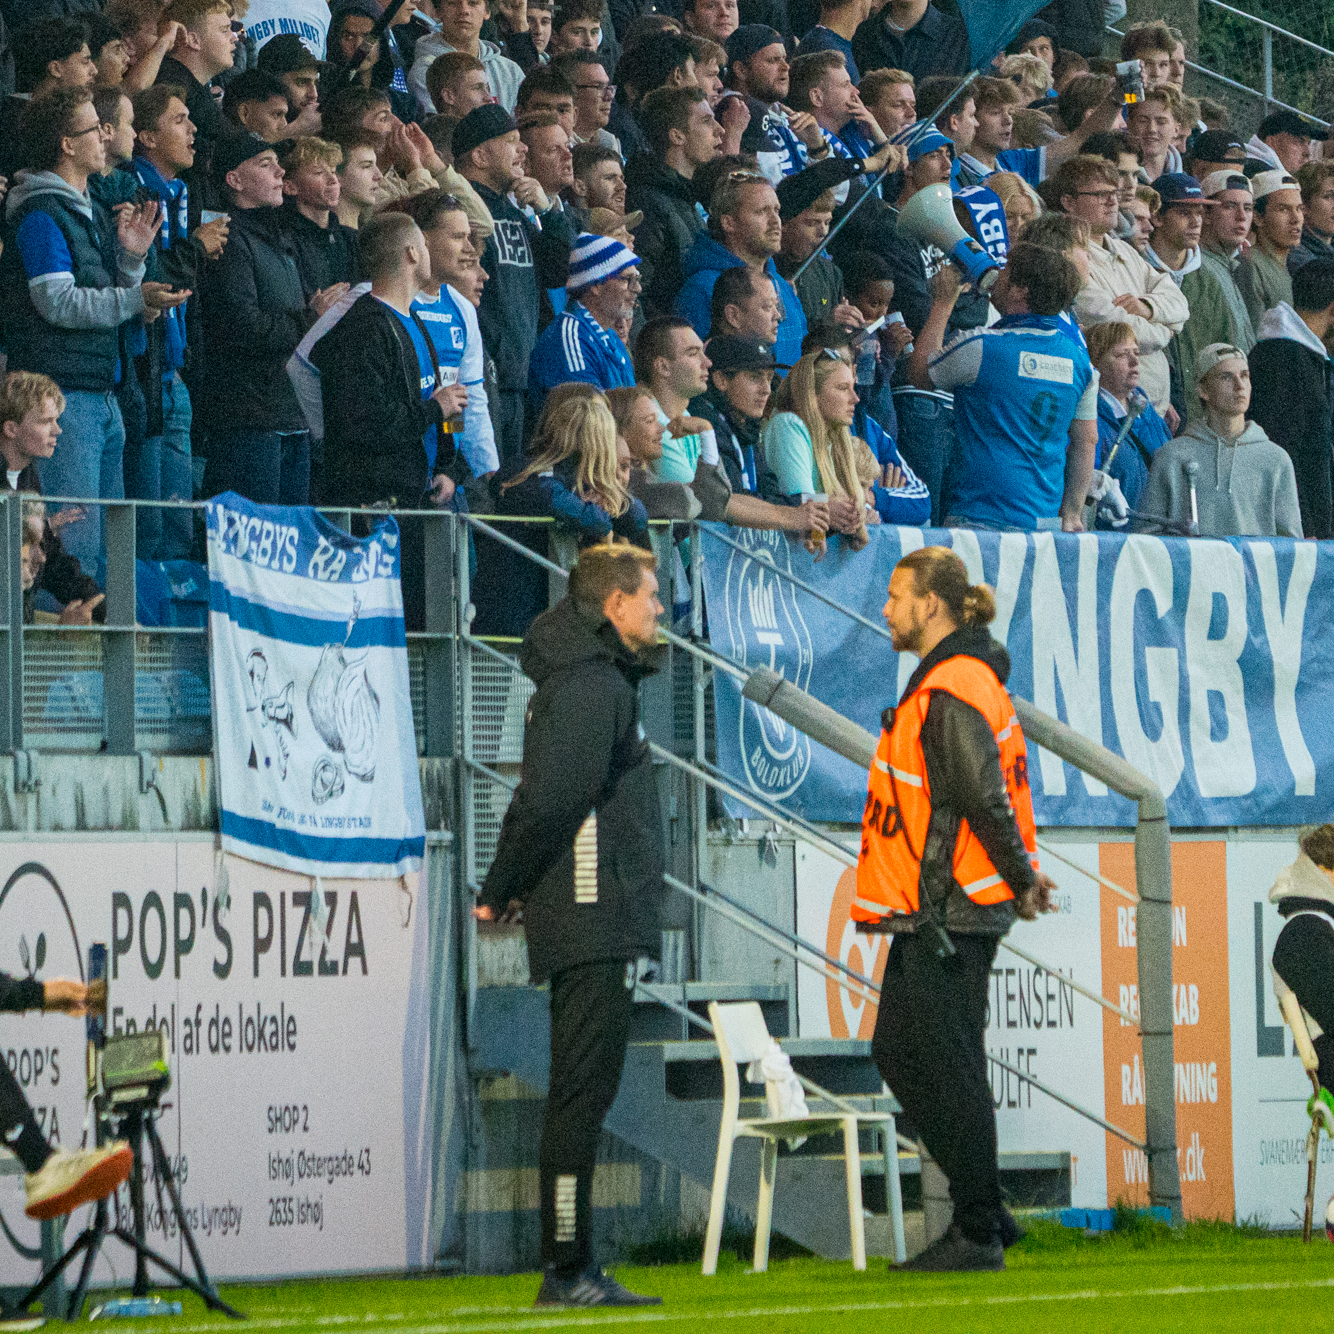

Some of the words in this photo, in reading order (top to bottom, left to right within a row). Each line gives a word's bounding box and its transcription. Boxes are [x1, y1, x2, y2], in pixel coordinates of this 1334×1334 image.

[751, 746, 805, 788] BOLDKLUB
[111, 886, 234, 982] POP'S
[252, 890, 369, 978] PIZZA
[183, 1003, 202, 1056] af
[208, 1003, 232, 1055] de
[238, 1002, 298, 1053] lokale
[267, 1105, 300, 1135] SHOP
[301, 1106, 310, 1133] 2
[268, 1153, 295, 1187] Ishøj
[297, 1151, 355, 1185] Østergade
[357, 1149, 372, 1178] 43
[200, 1202, 243, 1241] Lyngby
[268, 1199, 295, 1227] 2635
[297, 1195, 324, 1232] Ishøj
